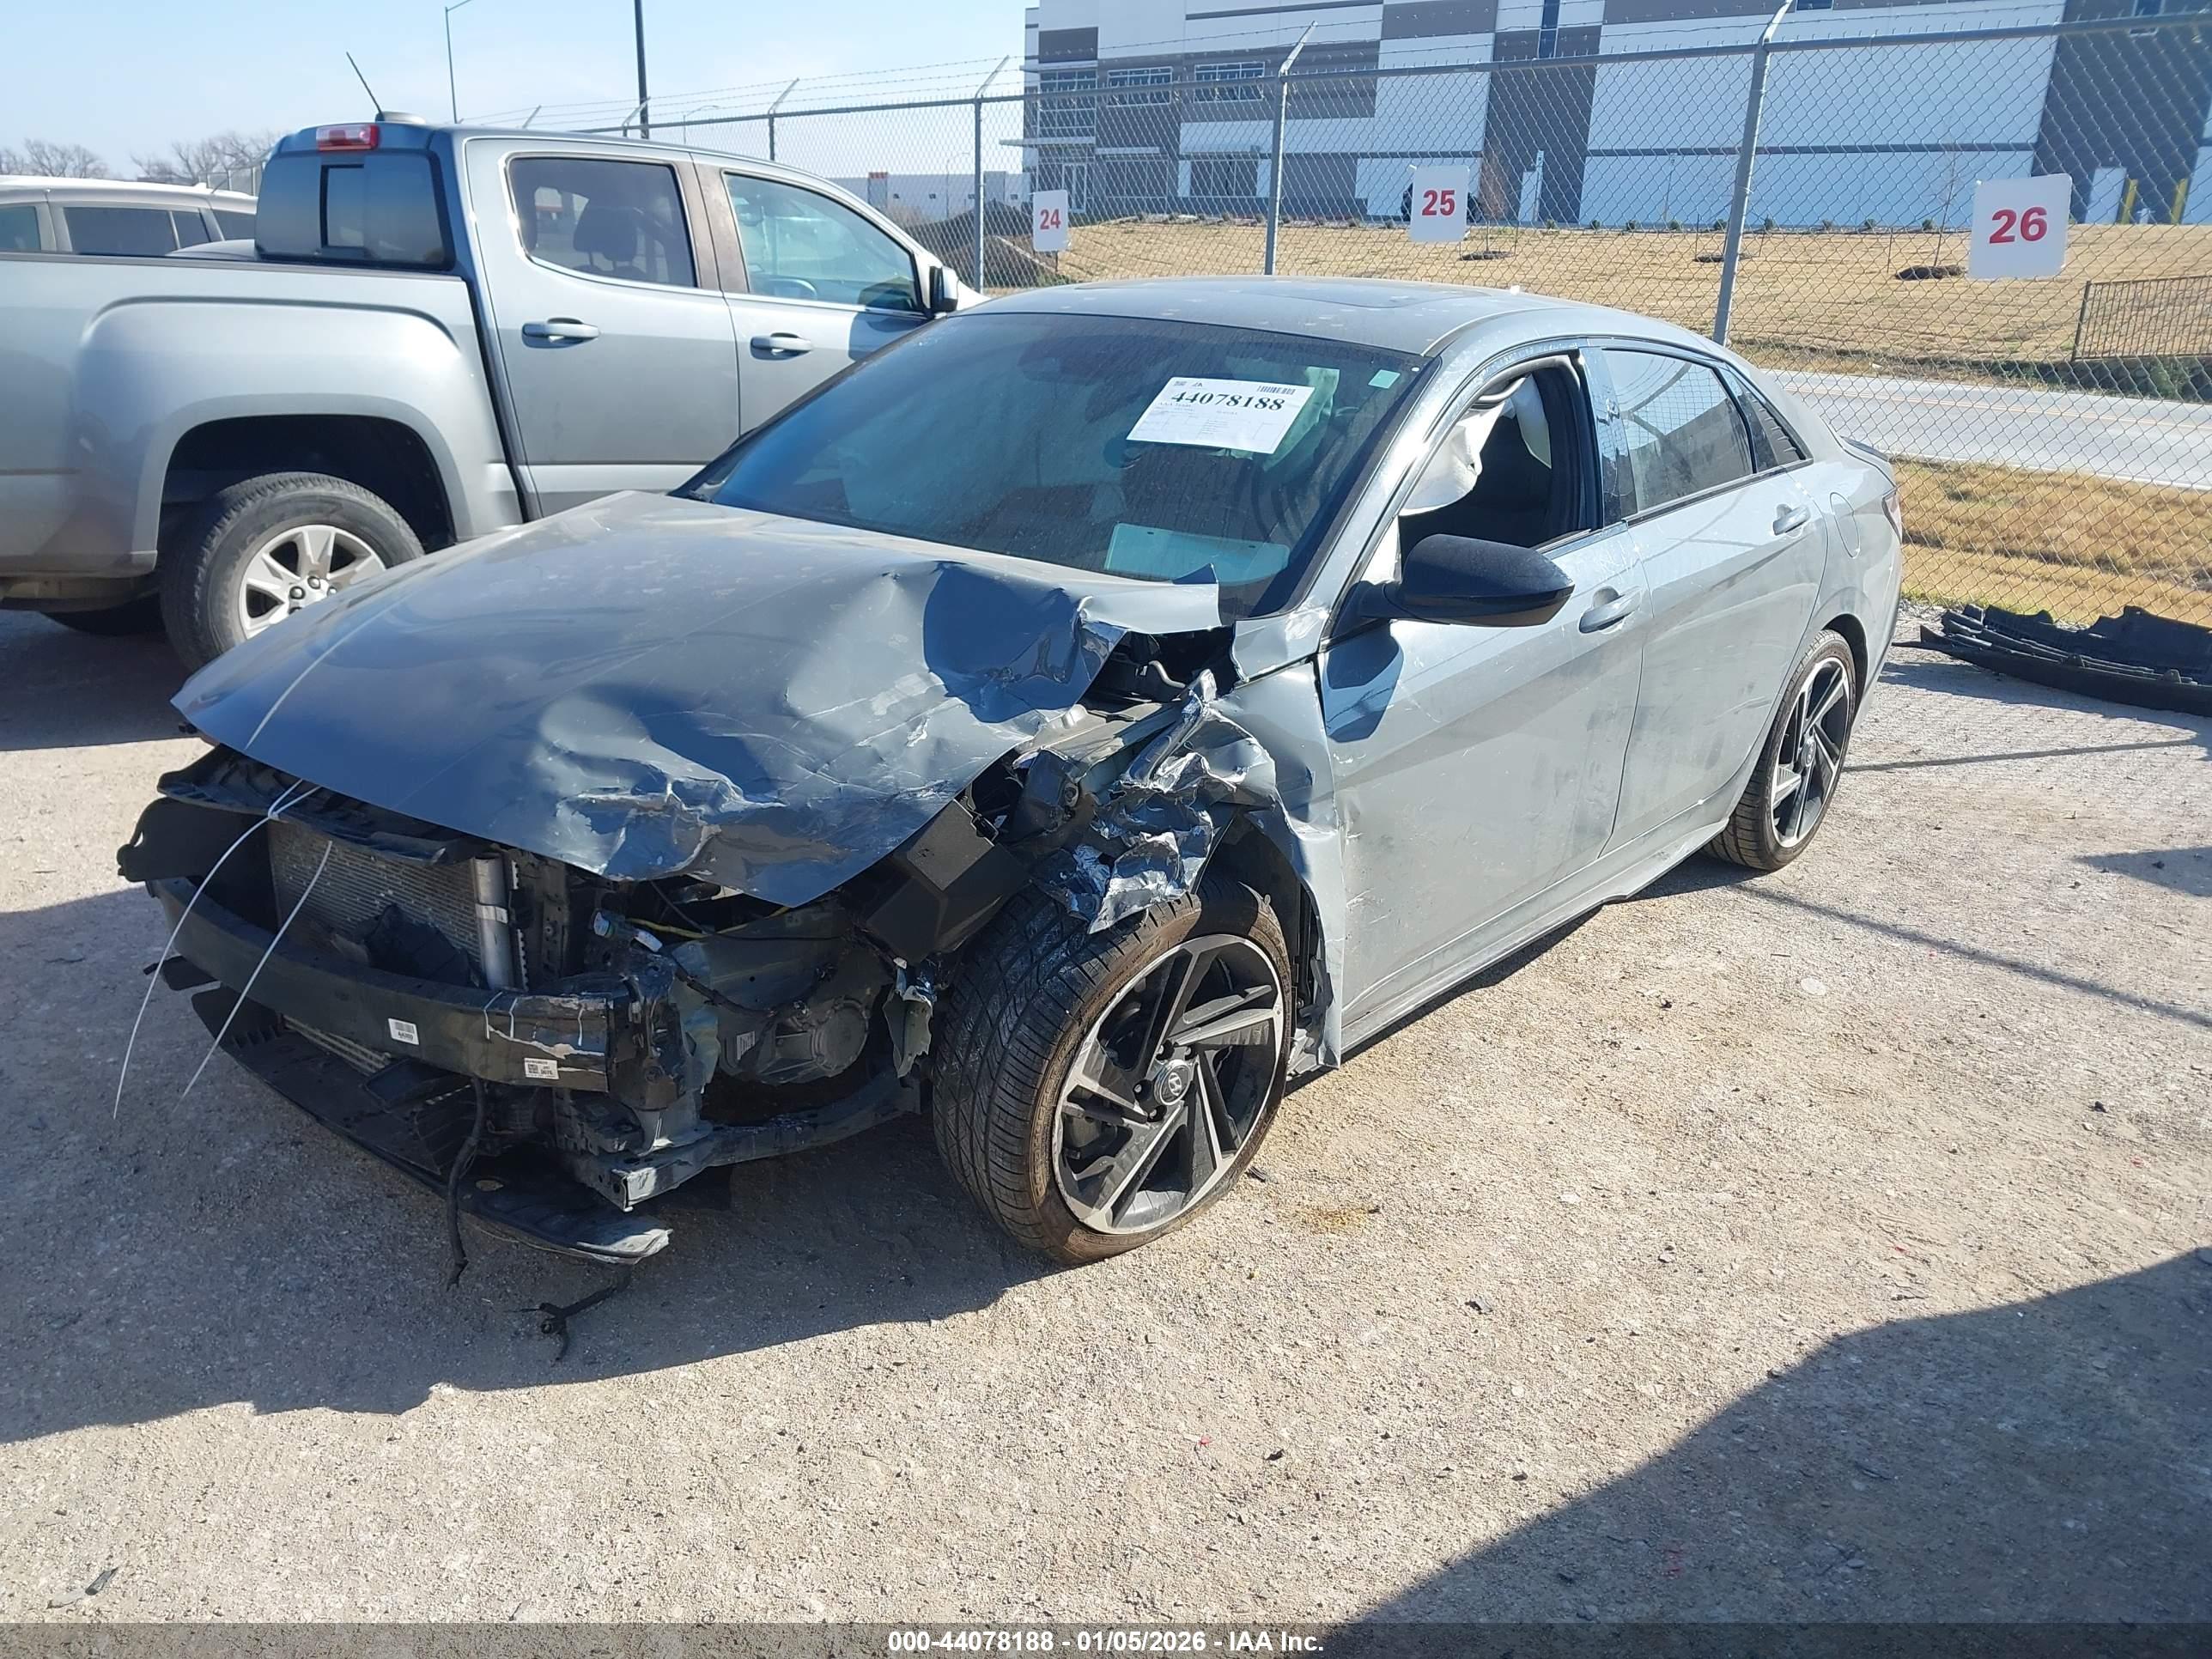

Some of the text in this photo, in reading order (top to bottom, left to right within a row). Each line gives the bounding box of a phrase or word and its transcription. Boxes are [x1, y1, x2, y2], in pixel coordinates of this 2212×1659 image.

[1422, 190, 1455, 216] 25
[1040, 209, 1061, 229] 24
[1989, 207, 2047, 244] 26
[1171, 391, 1285, 410] 44078188
